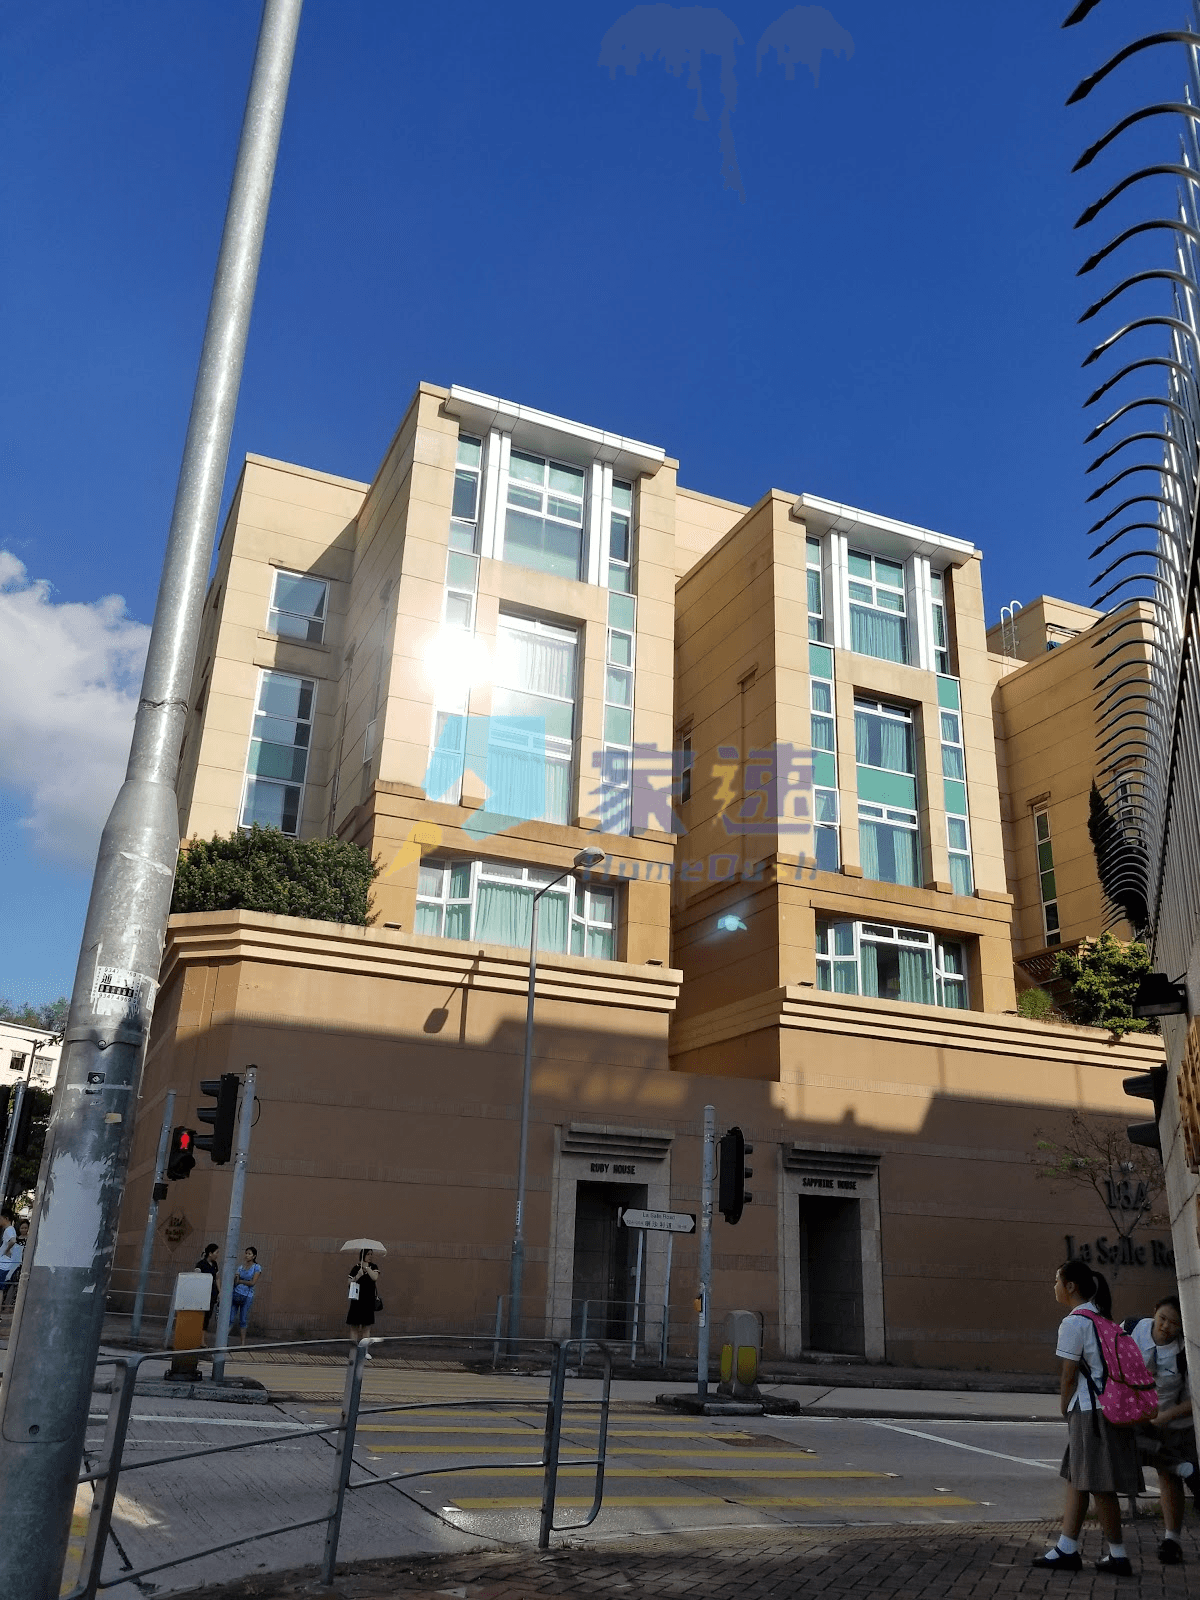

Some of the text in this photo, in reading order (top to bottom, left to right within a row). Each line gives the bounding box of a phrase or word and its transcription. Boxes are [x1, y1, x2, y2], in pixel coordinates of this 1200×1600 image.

[590, 1163, 636, 1174] RUBY HOUSE
[1064, 1235, 1092, 1263] La
[1096, 1236, 1146, 1266] Salle
